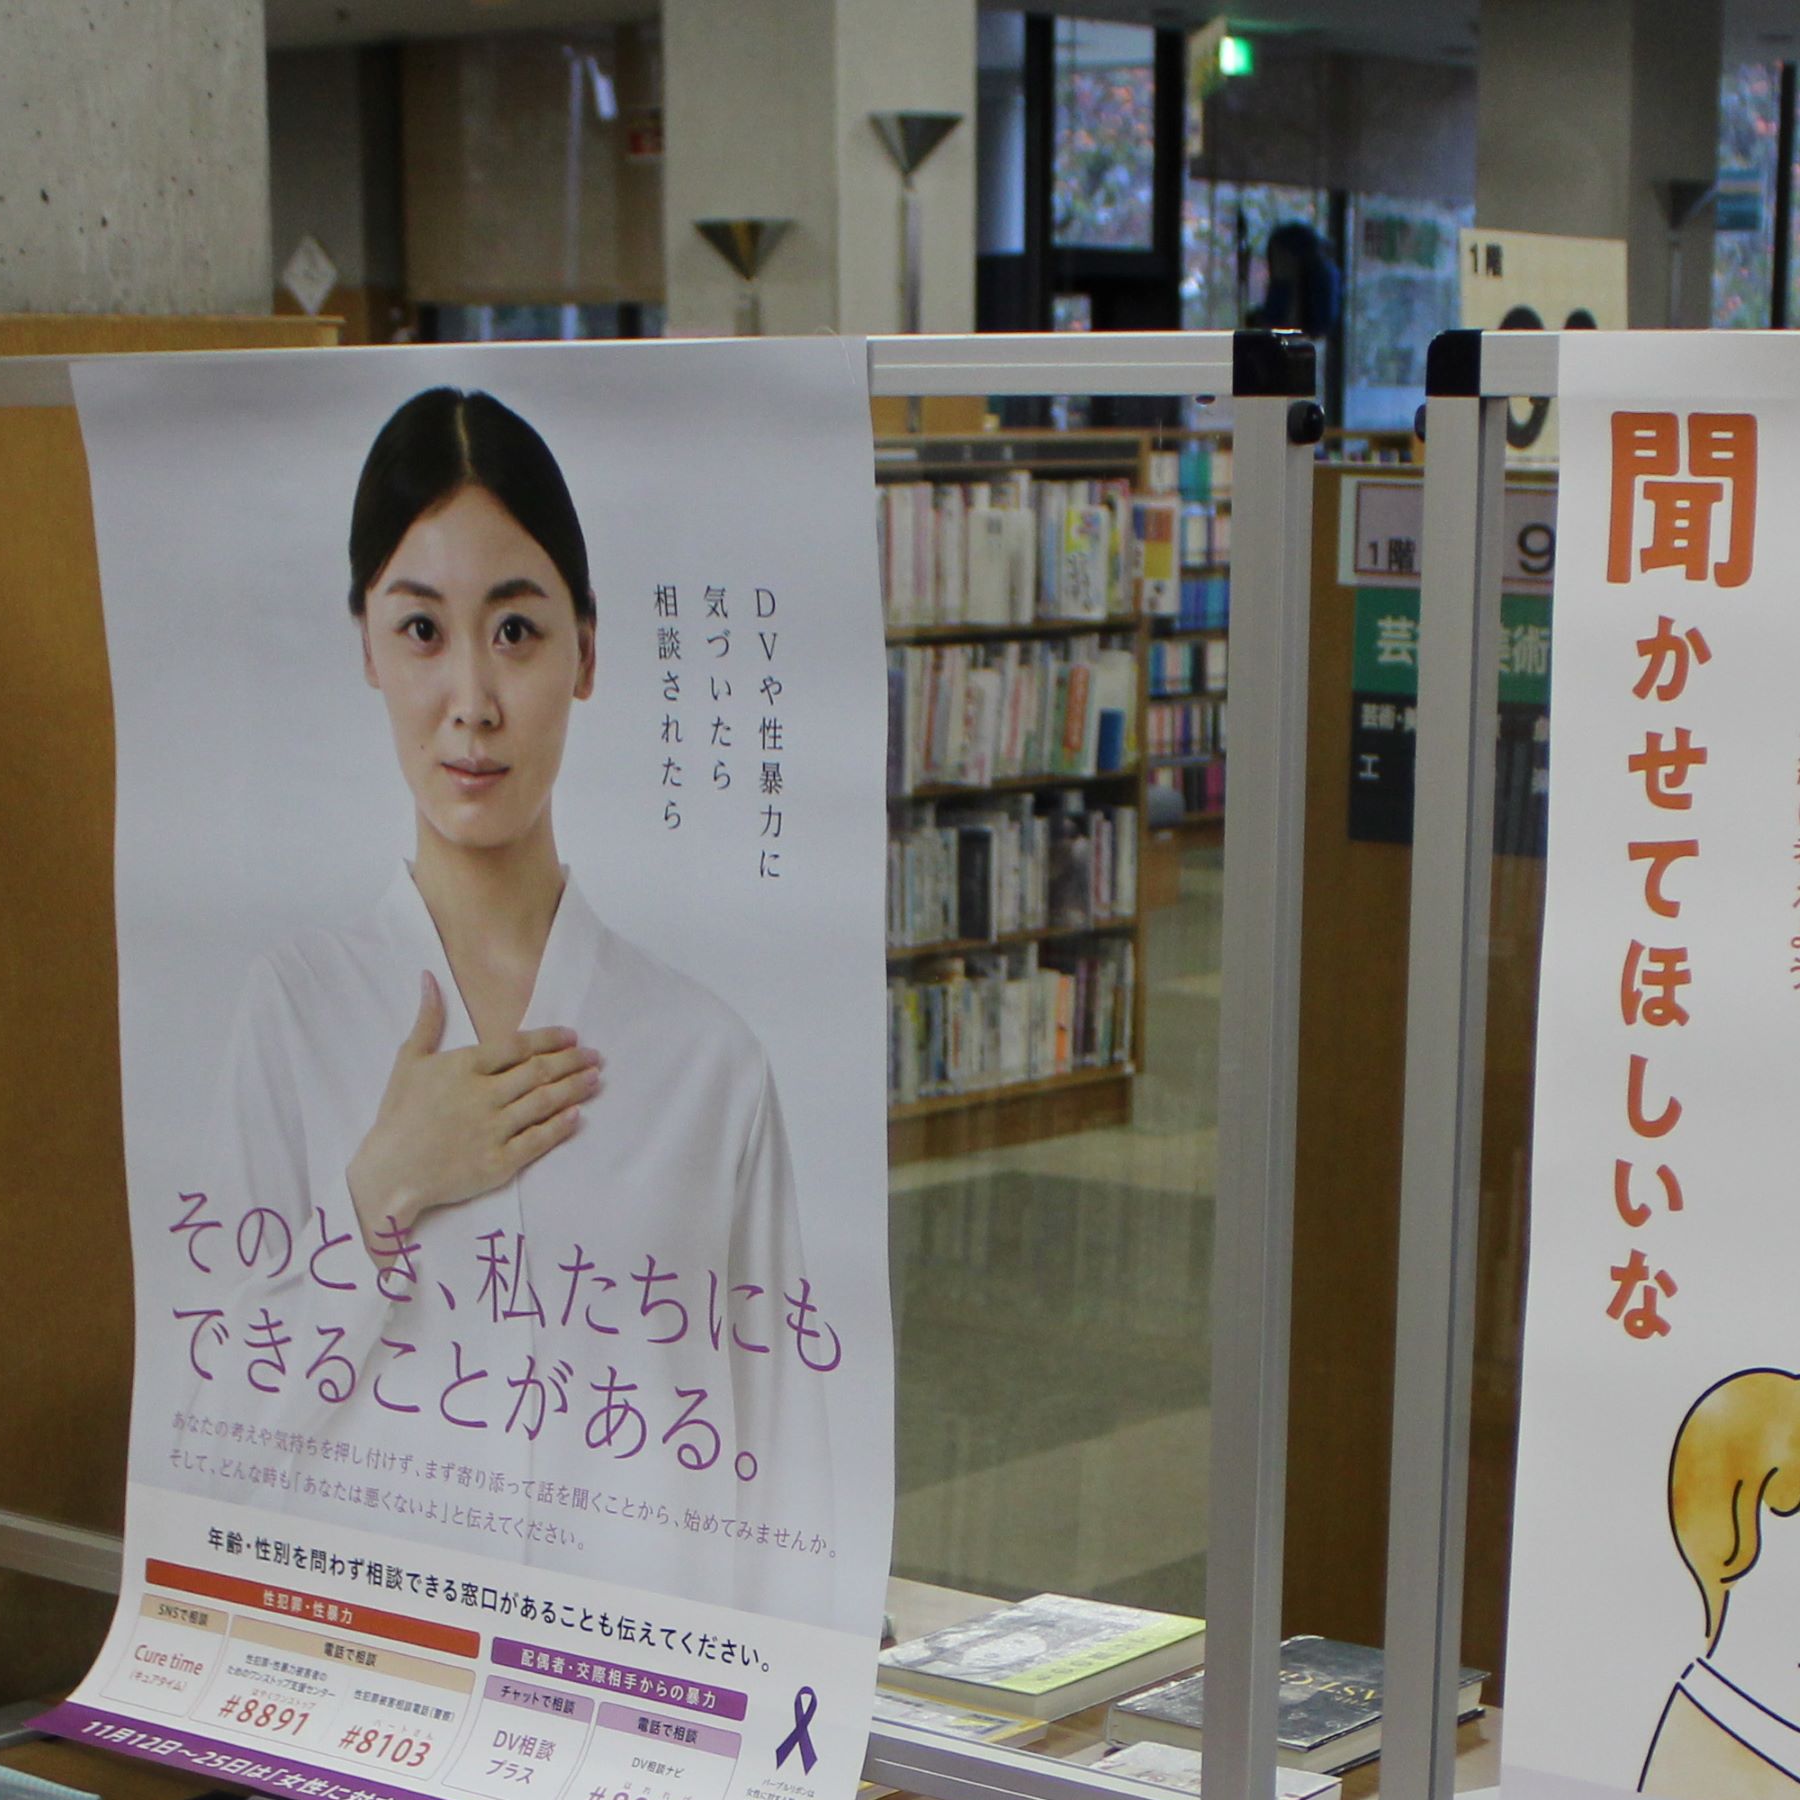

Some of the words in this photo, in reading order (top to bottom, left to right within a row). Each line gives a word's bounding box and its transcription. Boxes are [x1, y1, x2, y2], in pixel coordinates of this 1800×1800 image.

[1517, 523, 1556, 575] 9
[654, 584, 684, 832] 相談されたら
[703, 586, 735, 793] 気づいたら
[754, 587, 784, 880] DVや性暴力に
[1605, 411, 1759, 1340] 聞かせてほしいな
[168, 1191, 843, 1374] そのとき、私たちにも
[171, 1306, 760, 1483] できることがある。
[168, 1449, 585, 1551] そして、どんな時も「あなたは悪くないよ」と伝えてください。
[172, 1411, 836, 1560] あなたの考えや気持ちを押し付けず、まず寄り添って話を聞くことから、始めてみませんか。
[133, 1644, 168, 1668] Cure
[169, 1652, 205, 1677] time
[207, 1526, 771, 1673] 年齢・性別を問わず相談できる窓口があることも伝えてください。
[262, 1589, 354, 1626] 性犯罪・性暴力
[520, 1648, 717, 1710] 配偶者・交際相手からの暴力
[157, 1602, 209, 1626] SNSで相談
[323, 1641, 379, 1668] 電話で相談
[500, 1683, 577, 1716] チャットで相談
[636, 1715, 699, 1745] 電話で相談
[218, 1694, 311, 1737] #8891
[339, 1724, 432, 1769] #8103
[486, 1759, 535, 1786] プラス
[492, 1729, 558, 1763] DV相談
